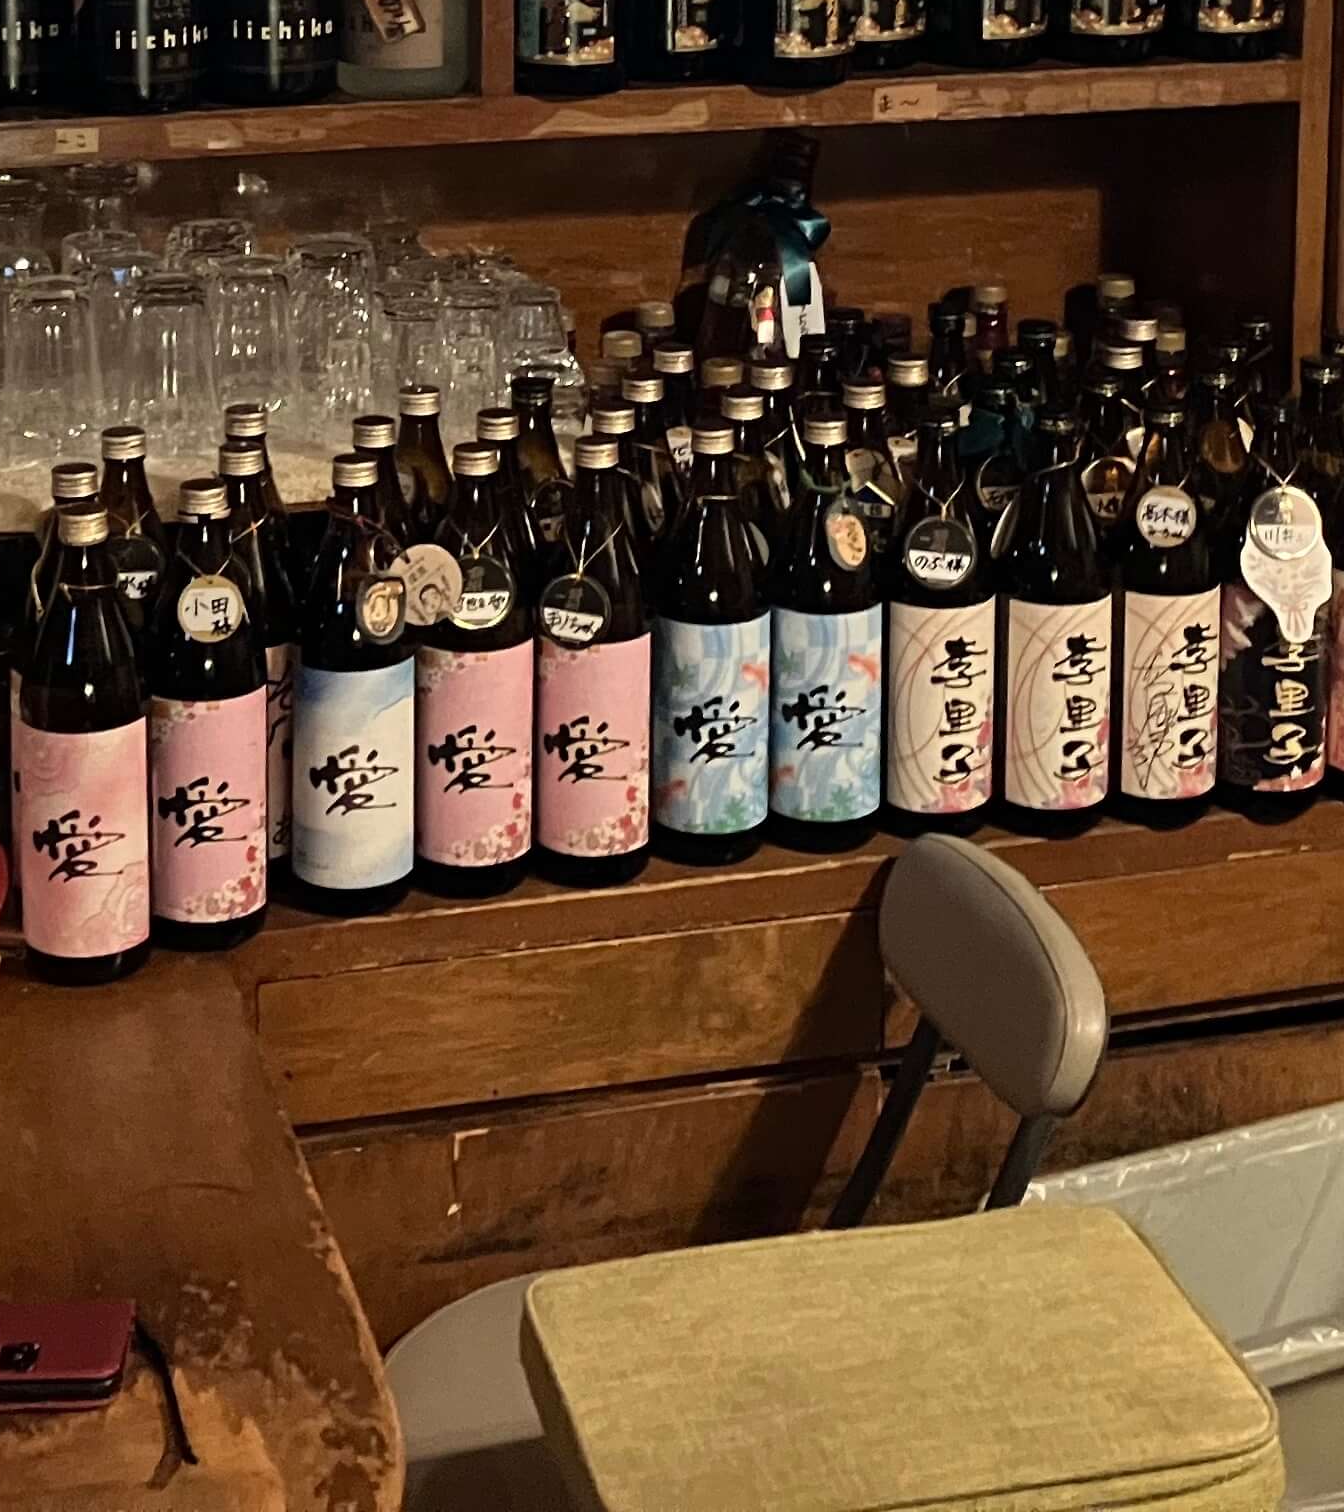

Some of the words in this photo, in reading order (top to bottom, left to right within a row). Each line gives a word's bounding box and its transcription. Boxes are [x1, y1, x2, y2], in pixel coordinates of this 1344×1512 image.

[231, 18, 334, 43] iichiko
[543, 716, 630, 784] 愛
[674, 696, 758, 764] 愛
[782, 685, 867, 752] 愛
[310, 745, 400, 816] 愛
[428, 725, 517, 793] 愛
[32, 809, 126, 883] 愛
[157, 776, 250, 849] 愛
